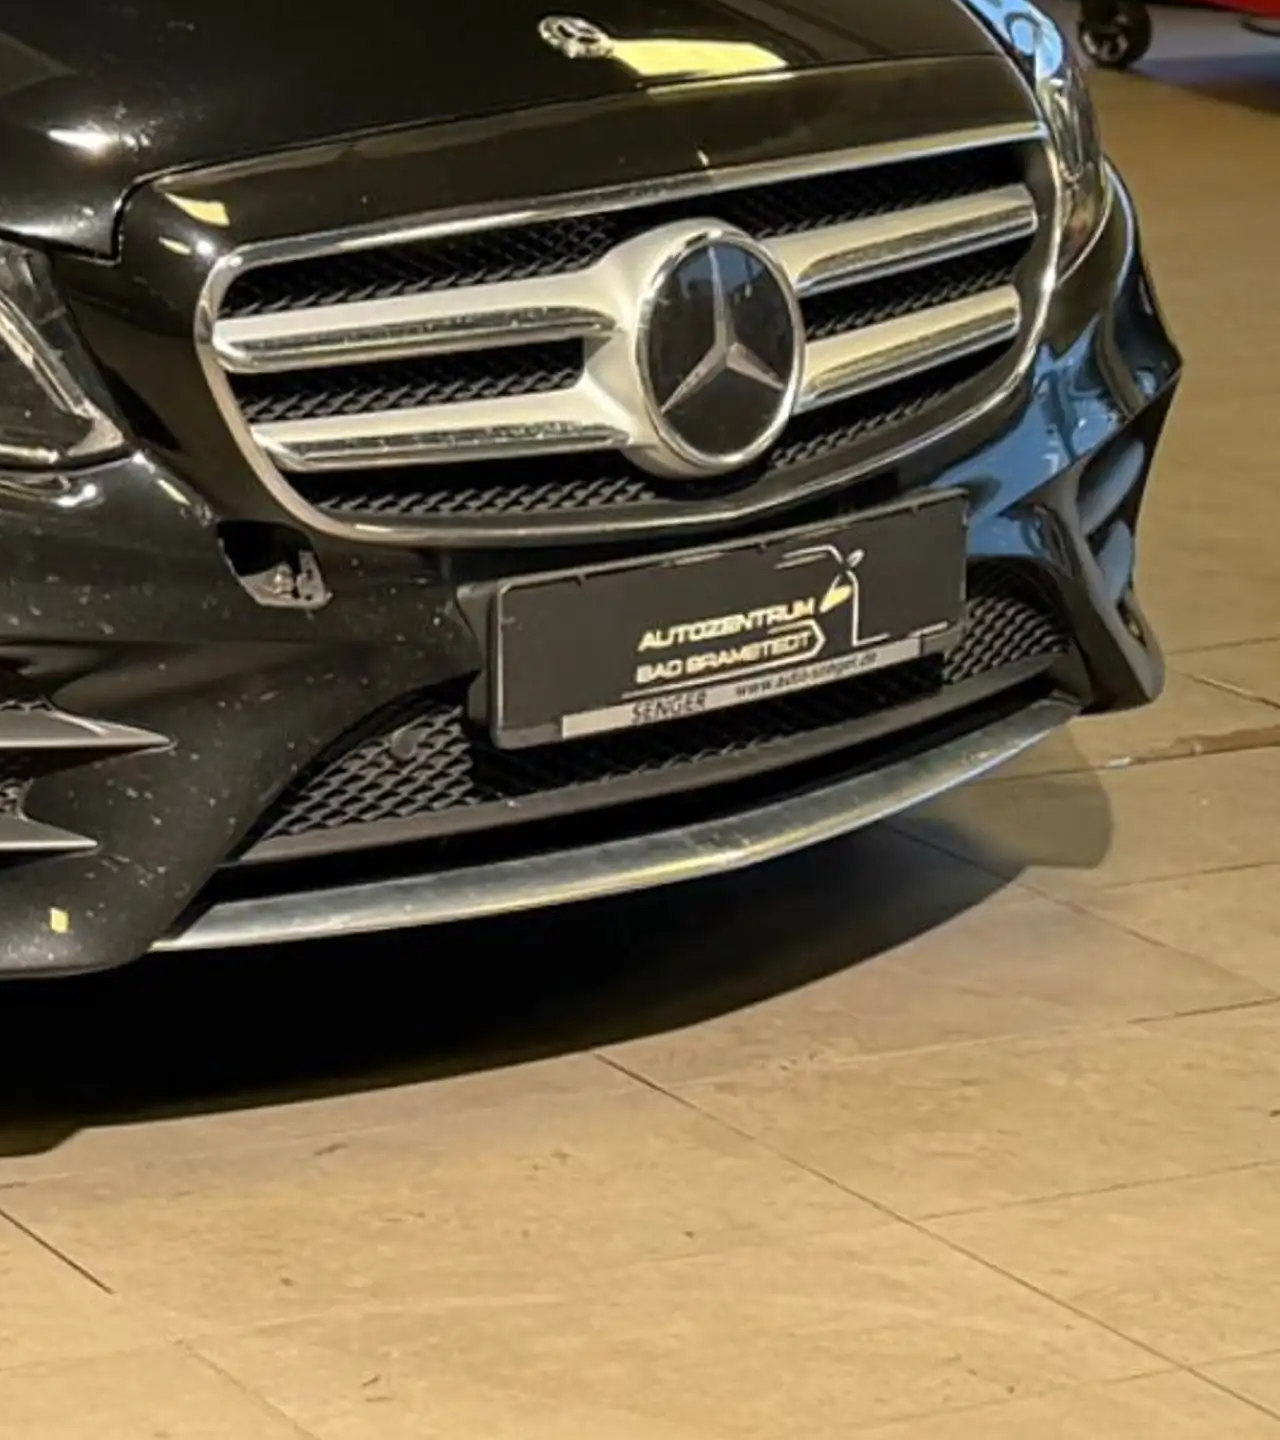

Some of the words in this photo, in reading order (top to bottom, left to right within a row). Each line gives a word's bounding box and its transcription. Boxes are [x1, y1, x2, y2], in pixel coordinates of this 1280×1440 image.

[637, 597, 816, 651] AUTOZENTRUM
[636, 658, 682, 684] BAD
[685, 631, 813, 674] BRAMSTEDT
[631, 691, 707, 725] SENGER
